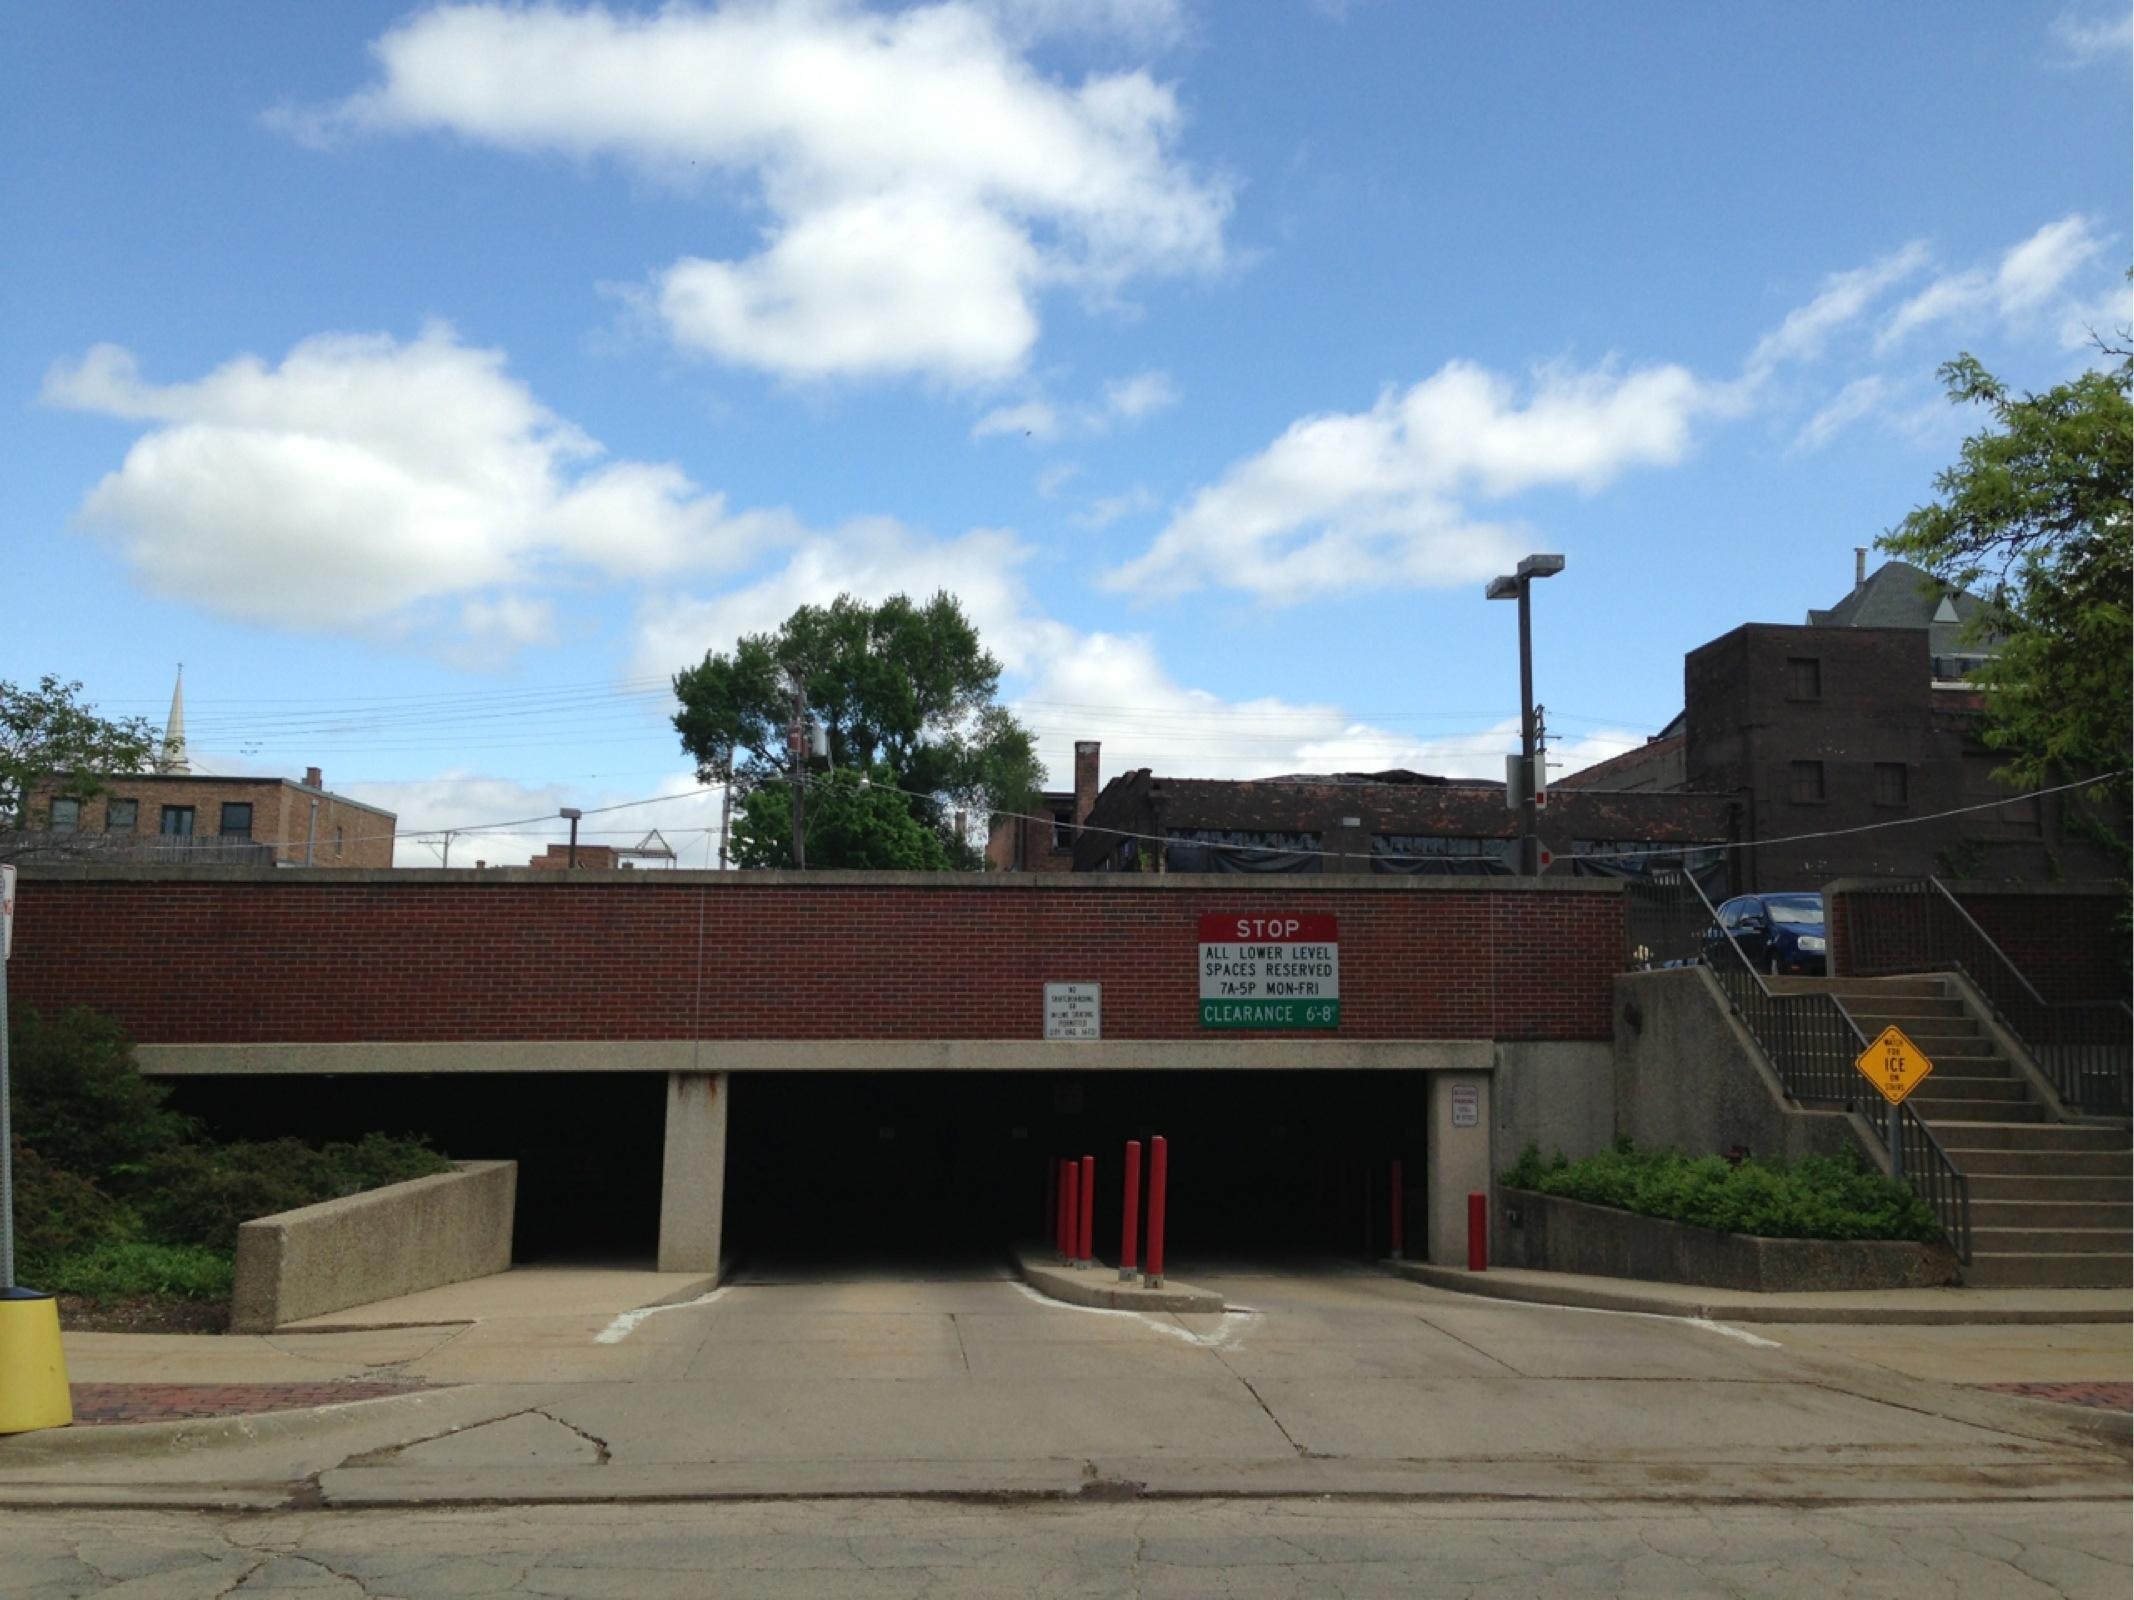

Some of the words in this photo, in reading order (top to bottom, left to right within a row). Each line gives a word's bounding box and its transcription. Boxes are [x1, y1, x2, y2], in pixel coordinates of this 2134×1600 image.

[1237, 919, 1300, 938] STOP
[1206, 947, 1230, 959] ALL
[1239, 947, 1283, 959] LOWER
[1292, 947, 1331, 960] LEVEL
[1206, 963, 1256, 976] SPACES
[1266, 963, 1333, 977] RESERVED
[1220, 982, 1256, 995] 7A-5P
[1266, 982, 1320, 995] MON-FRI
[1204, 1006, 1294, 1022] CLEARANCE
[1884, 1057, 1906, 1073] ICE
